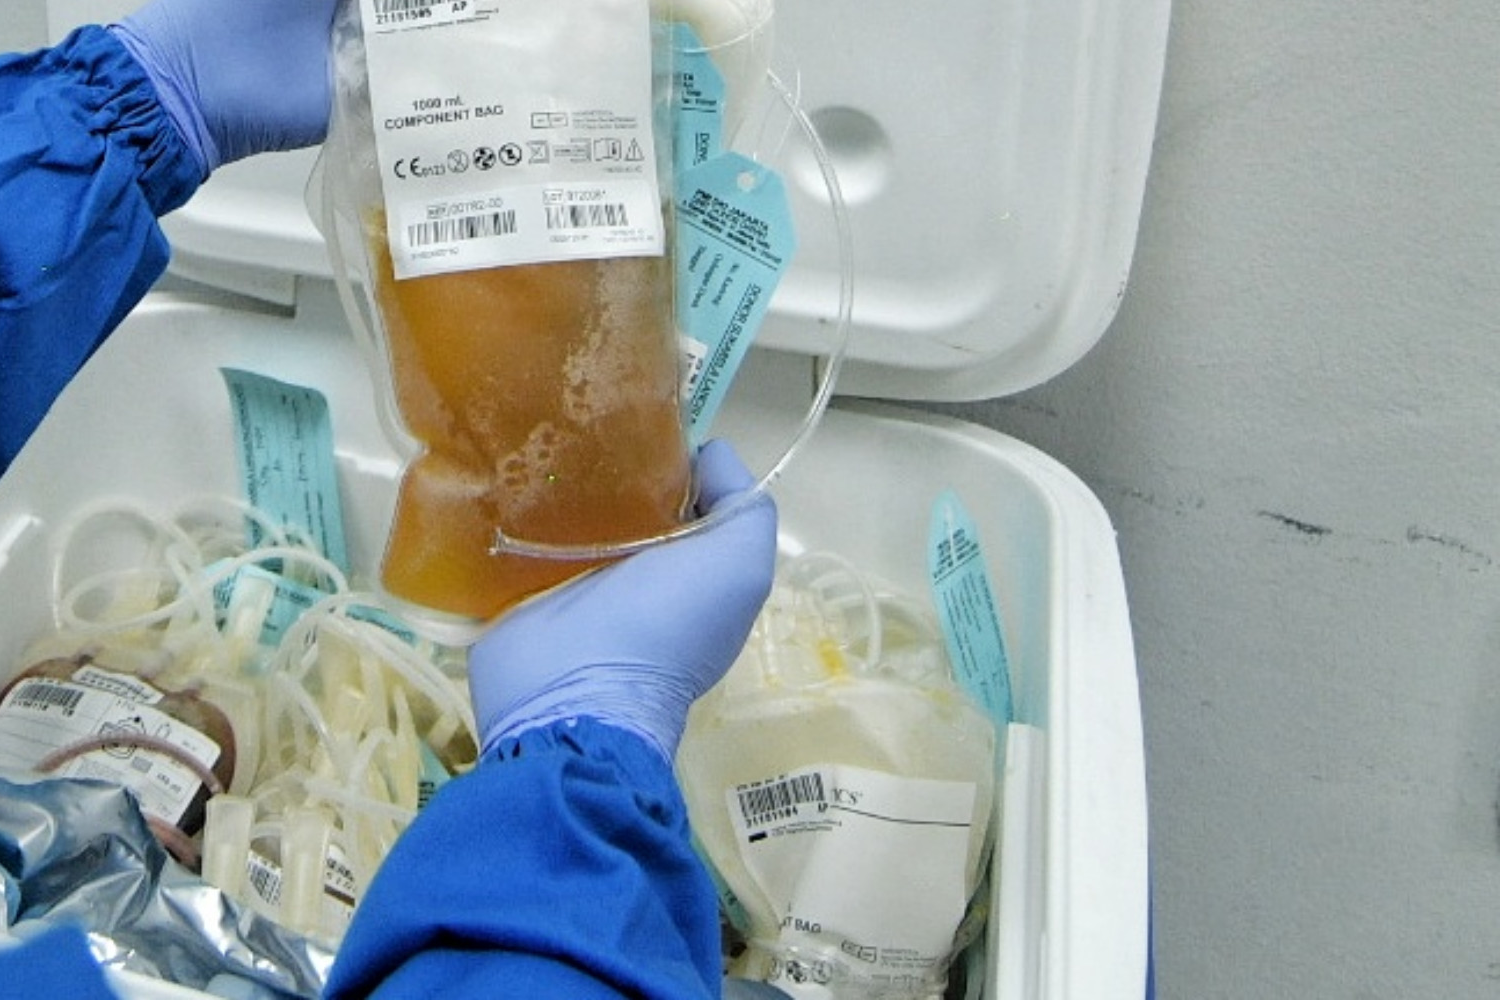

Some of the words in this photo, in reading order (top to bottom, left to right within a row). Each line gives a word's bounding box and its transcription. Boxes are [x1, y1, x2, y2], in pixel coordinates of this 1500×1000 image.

[384, 109, 470, 130] COMPONENT
[475, 104, 504, 118] BAG
[412, 98, 441, 111] 1000
[729, 206, 769, 231] JAKARTA
[736, 284, 762, 325] DONOR
[795, 918, 821, 933] BAG
